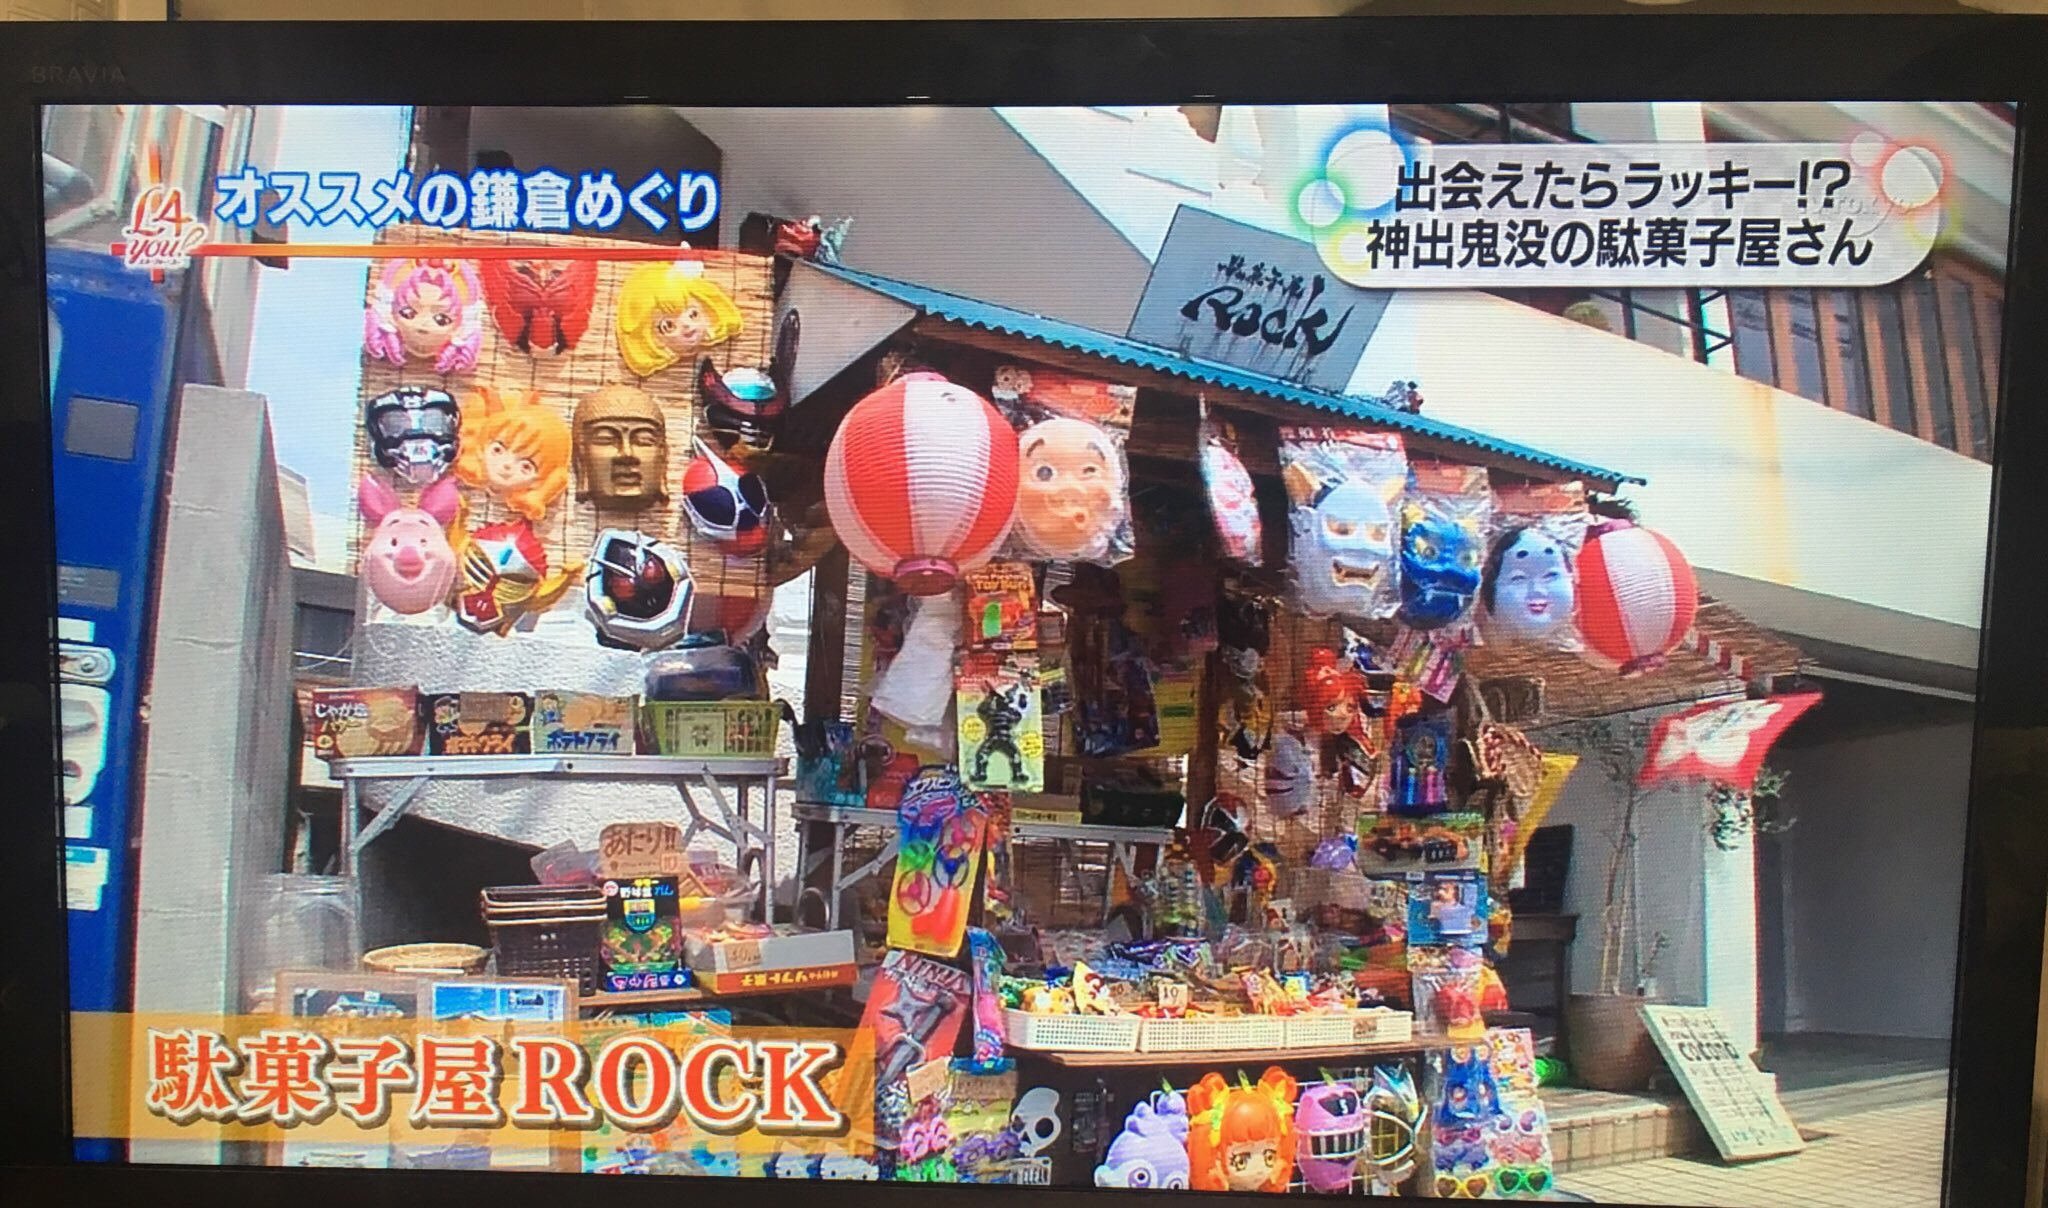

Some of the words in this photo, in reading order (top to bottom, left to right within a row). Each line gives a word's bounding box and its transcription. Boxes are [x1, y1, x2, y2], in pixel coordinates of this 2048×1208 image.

[31, 66, 126, 84] BRAVIA
[215, 166, 720, 232] オススメの鎌倉めぐり
[1367, 218, 1874, 269] 神出鬼没の駄菓子屋さん
[146, 1028, 498, 1121] 駄菓子屋
[515, 1036, 844, 1130] ROCK
